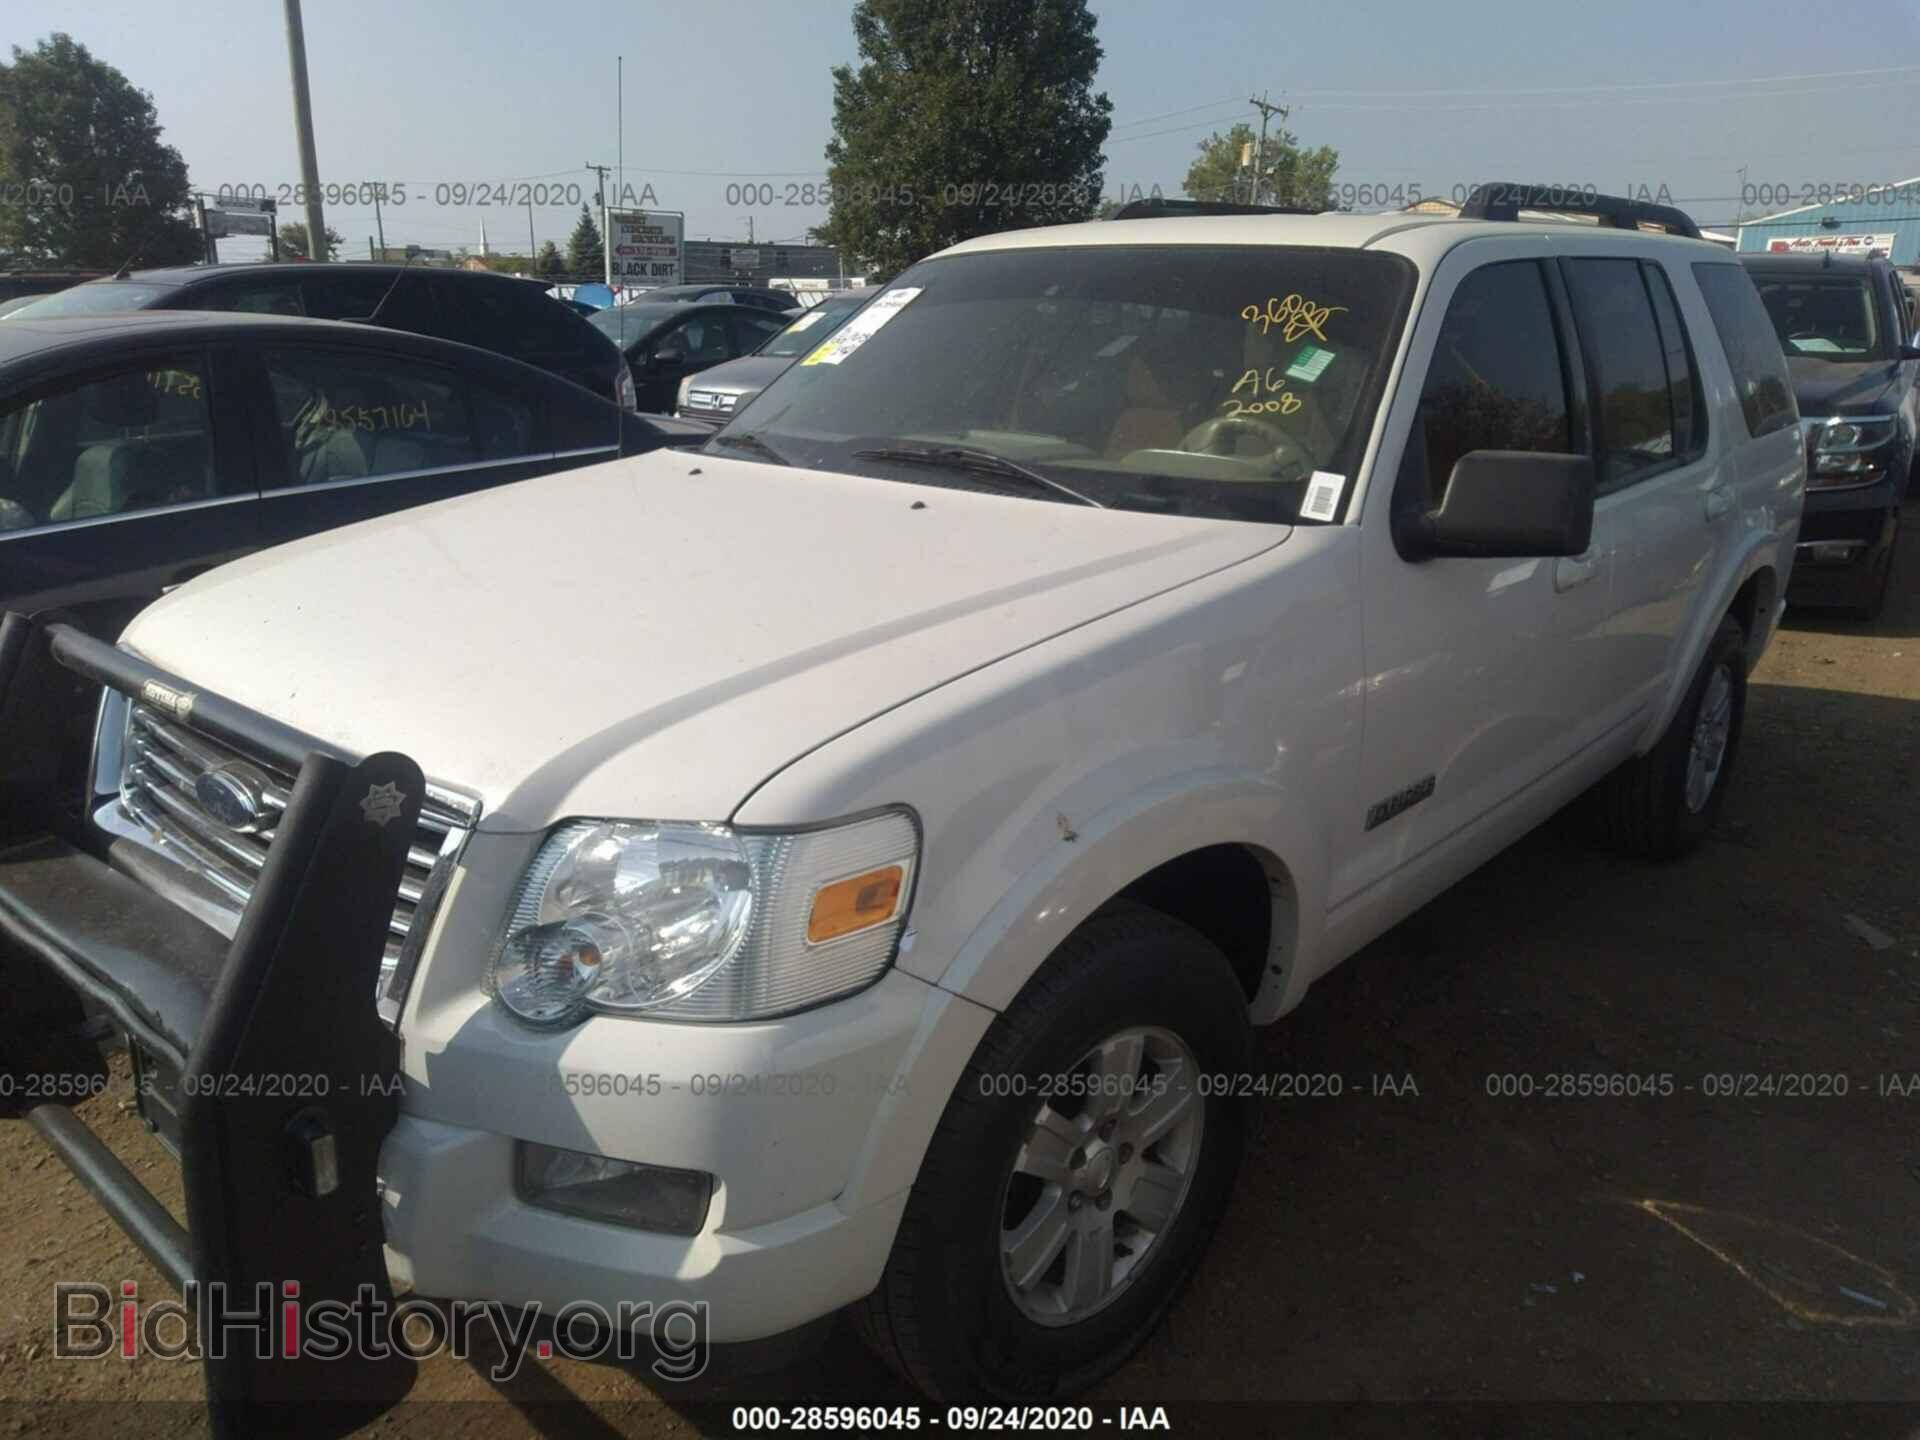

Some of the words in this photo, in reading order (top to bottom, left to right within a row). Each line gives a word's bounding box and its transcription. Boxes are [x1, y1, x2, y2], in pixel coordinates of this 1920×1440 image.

[611, 261, 648, 277] BLACK
[651, 262, 675, 277] DIRT
[1231, 367, 1286, 397] A6
[1221, 391, 1302, 418] 2008
